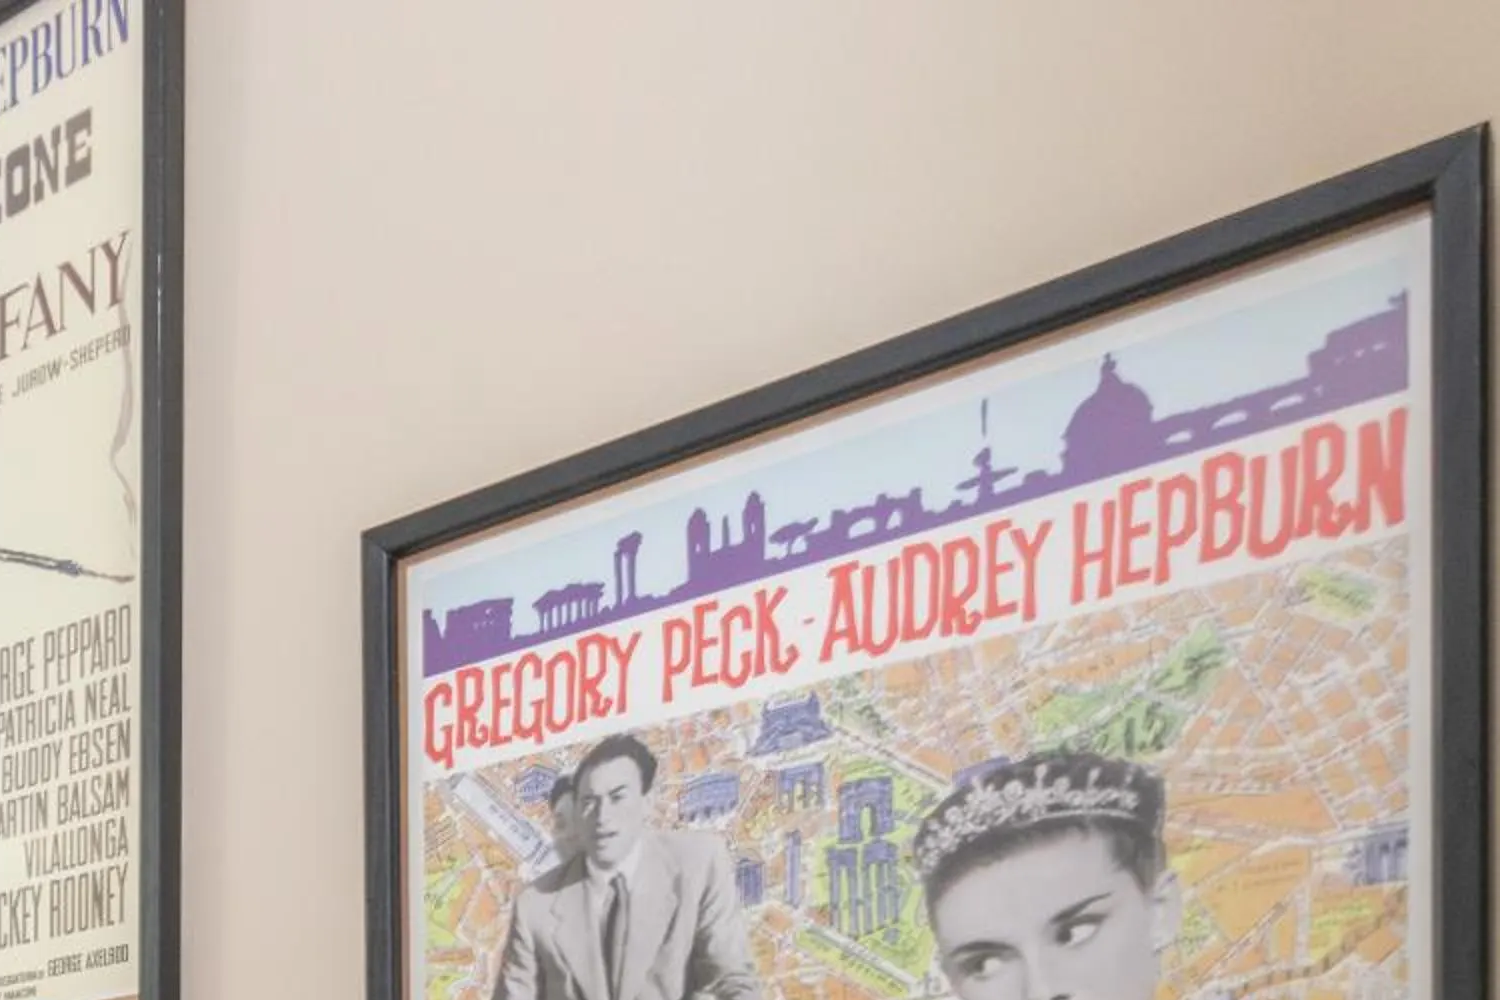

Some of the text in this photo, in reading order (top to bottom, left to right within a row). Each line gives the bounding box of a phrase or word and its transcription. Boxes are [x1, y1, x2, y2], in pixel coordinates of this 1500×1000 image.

[424, 630, 642, 770] GREGORY
[661, 585, 800, 703] PECK
[819, 518, 1053, 664] AUDREY
[1070, 407, 1410, 605] HEPBURN
[43, 604, 130, 690] PEPPARD
[85, 672, 131, 724] NEAL
[1, 717, 130, 794] BUDDY EBSEN
[57, 766, 130, 825] BALSAM
[50, 862, 129, 938] ROONEY
